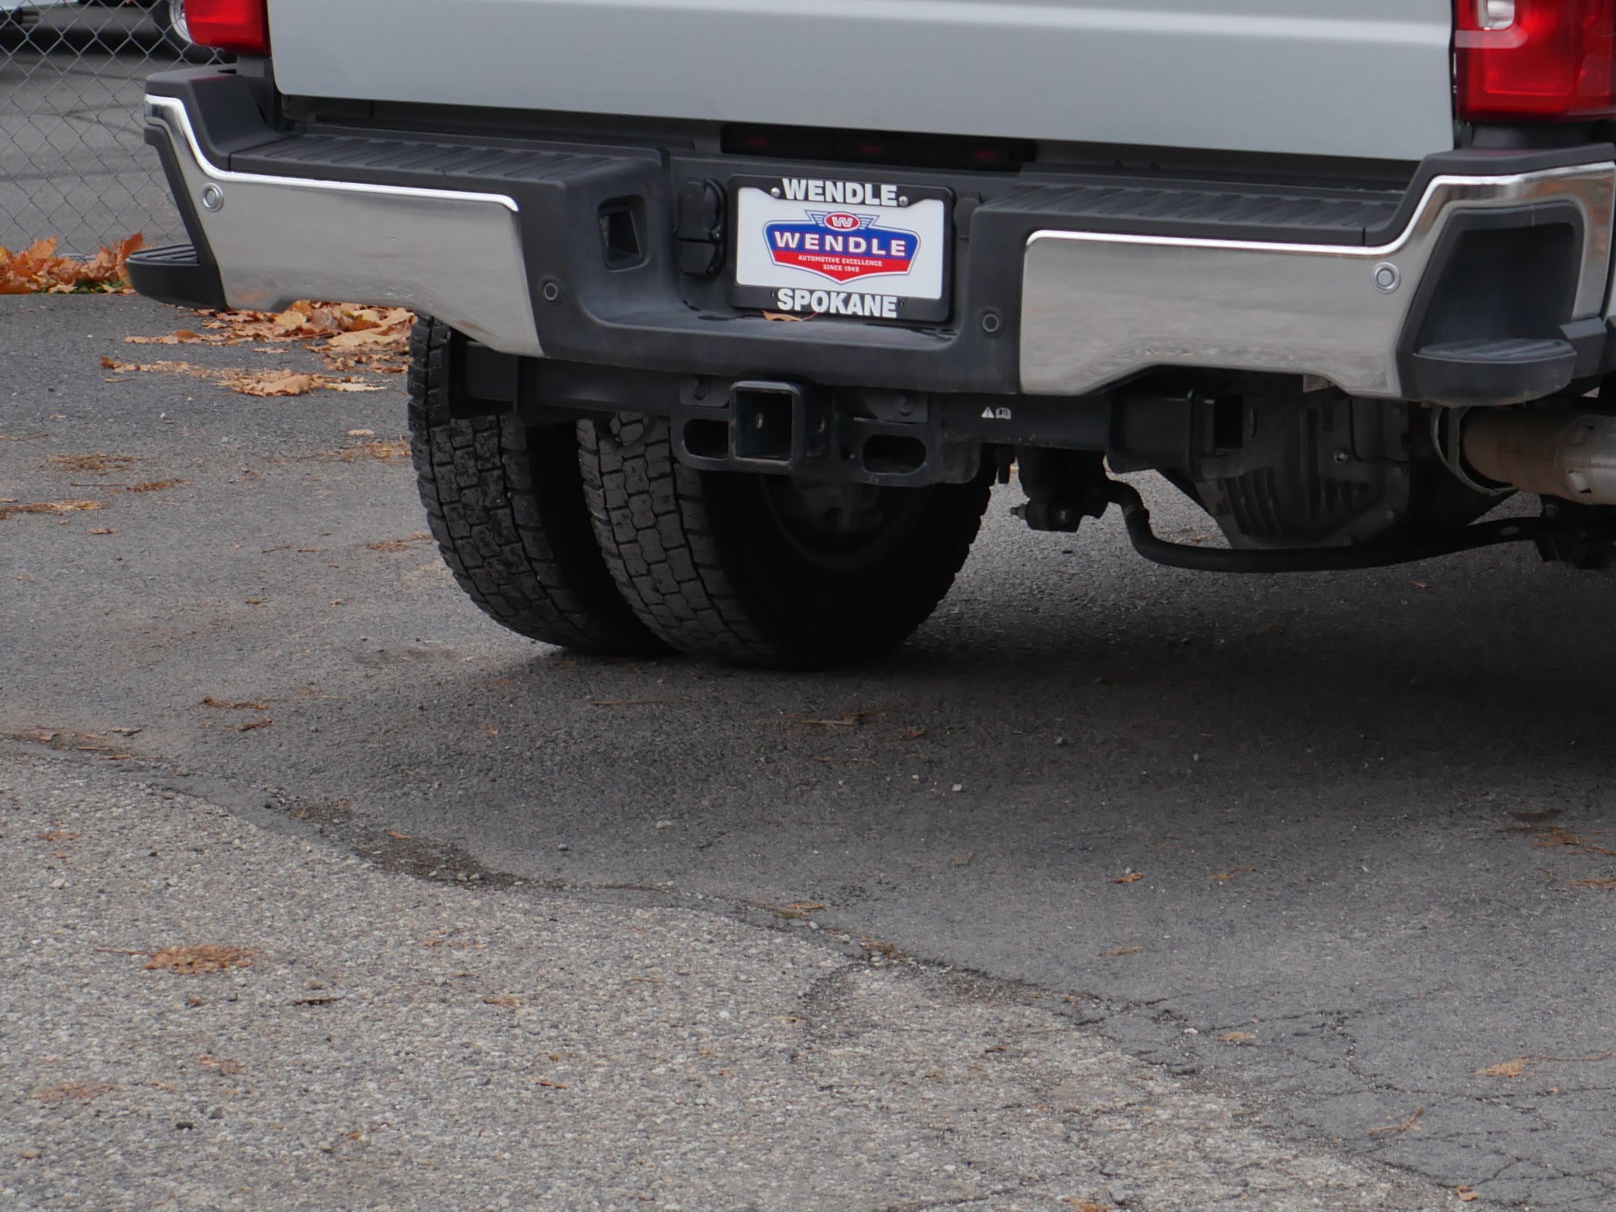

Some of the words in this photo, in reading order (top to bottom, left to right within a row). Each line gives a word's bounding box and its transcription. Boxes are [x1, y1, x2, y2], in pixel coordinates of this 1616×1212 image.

[782, 178, 898, 207] WENDLE
[831, 216, 854, 228] W
[774, 231, 906, 257] WENDLE
[798, 255, 841, 264] AUTOMOTIVE
[841, 257, 883, 267] EXCELLENCE
[823, 264, 843, 272] SINCE
[777, 288, 898, 319] SPOKANE
